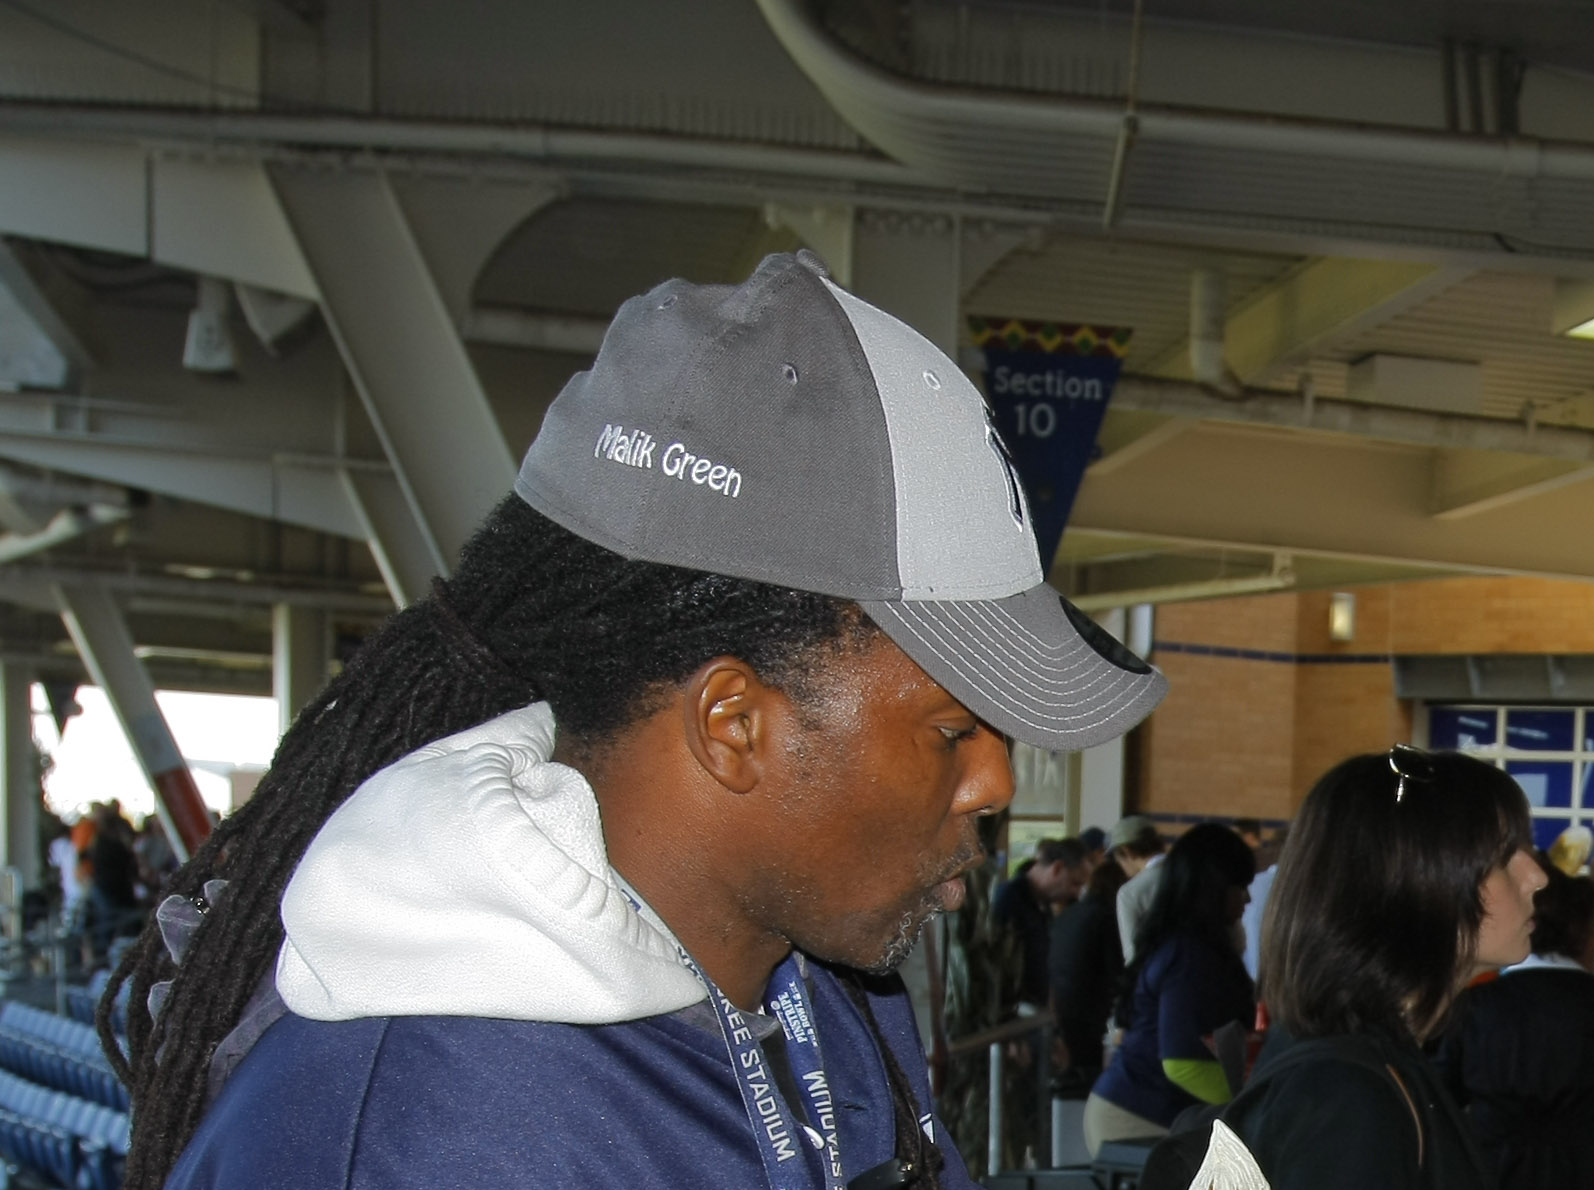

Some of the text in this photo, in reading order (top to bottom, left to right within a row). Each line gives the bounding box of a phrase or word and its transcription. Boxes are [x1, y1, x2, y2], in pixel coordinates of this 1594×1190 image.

[994, 365, 1103, 400] Section
[1014, 403, 1057, 438] 10
[594, 423, 743, 498] Malik Green
[777, 991, 808, 1044] PINSTRIPE
[740, 1048, 796, 1163] STADIUM
[802, 1070, 843, 1178] STADIUM
